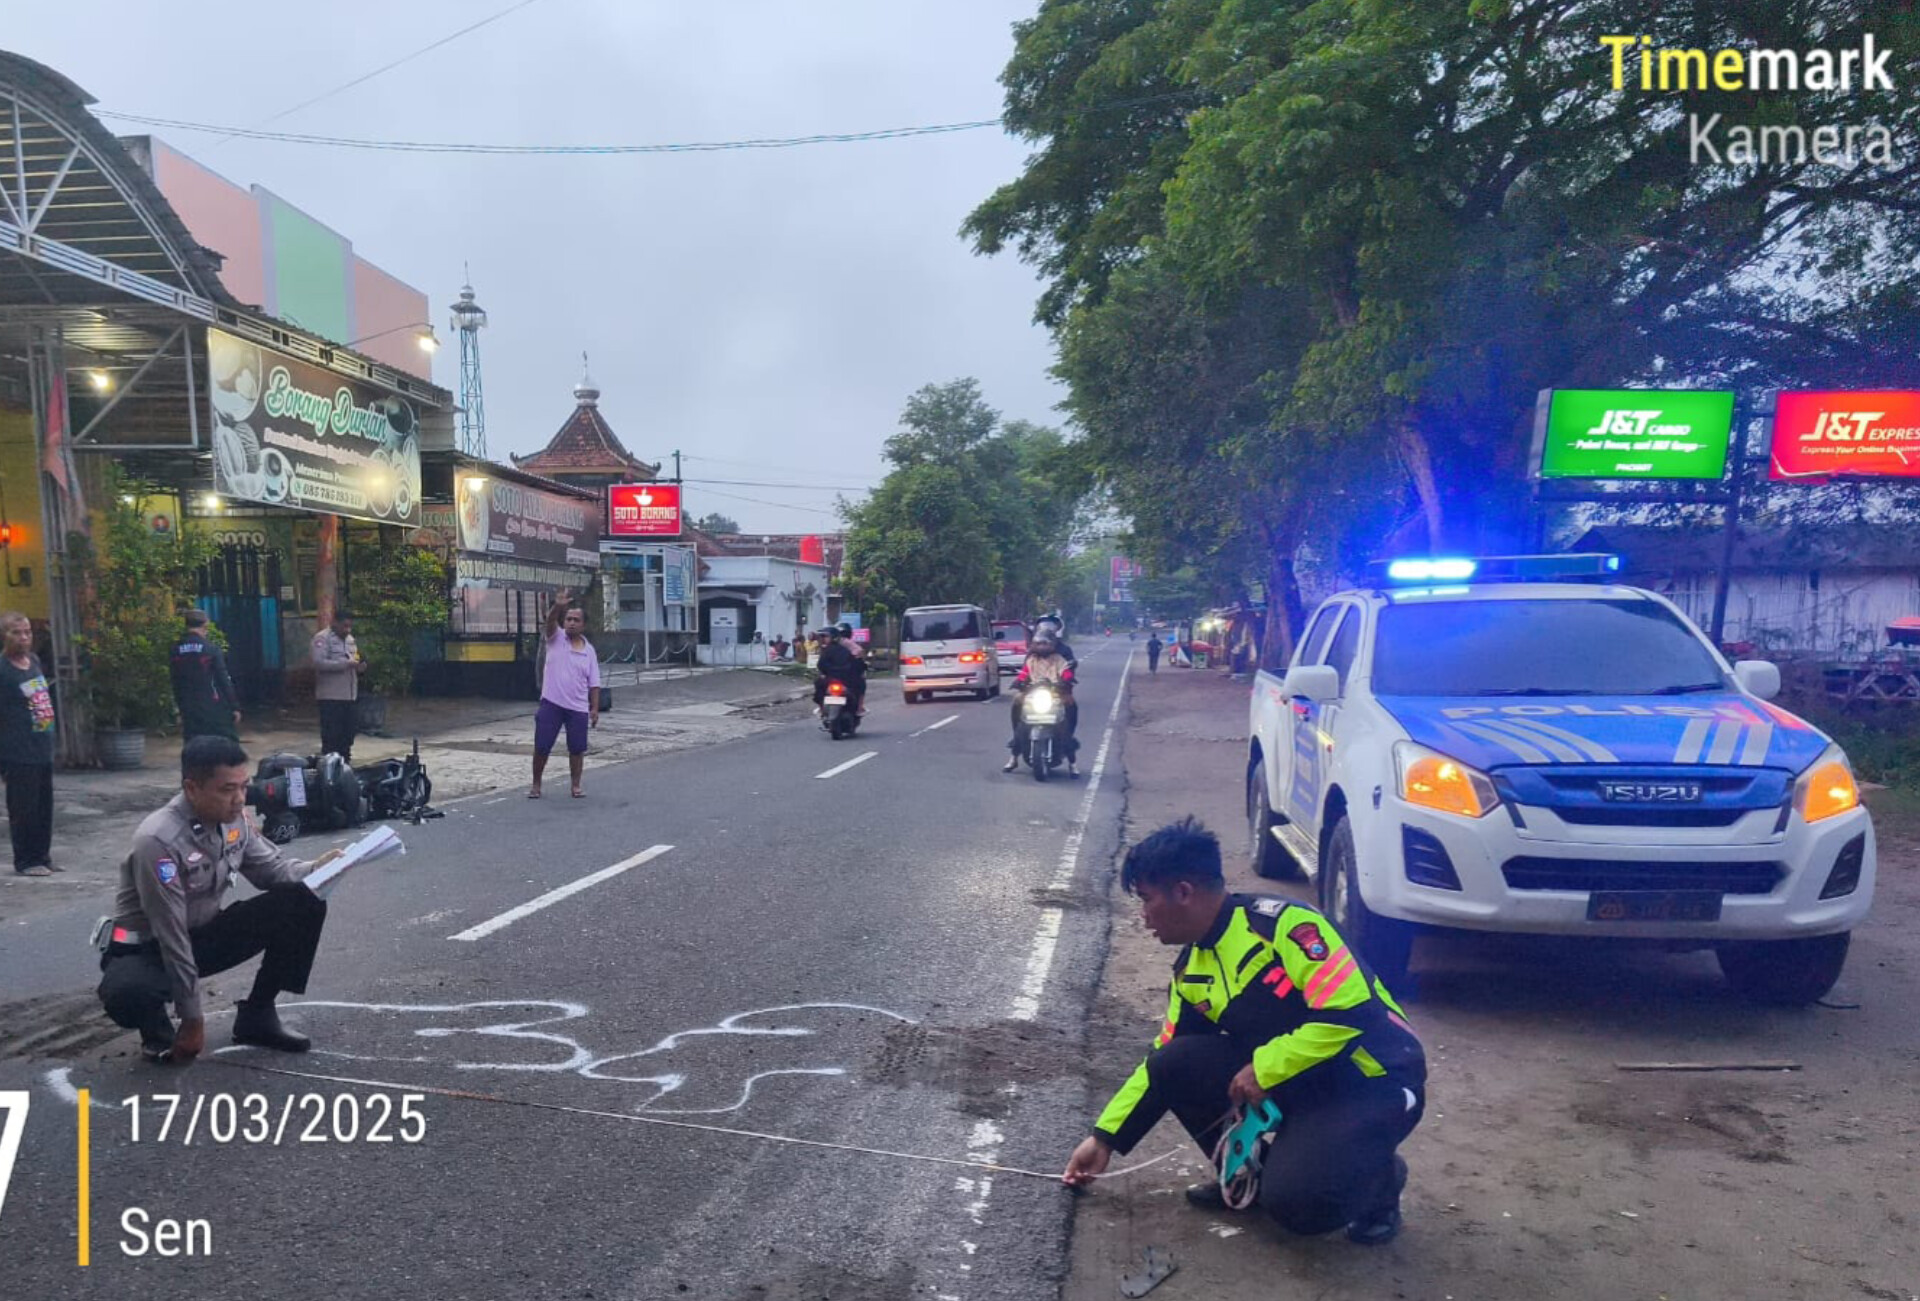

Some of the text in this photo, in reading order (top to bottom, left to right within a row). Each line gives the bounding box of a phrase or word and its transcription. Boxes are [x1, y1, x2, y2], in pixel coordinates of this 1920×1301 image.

[264, 366, 388, 444] Borang Durian
[1587, 410, 1664, 435] J&T
[1799, 412, 1886, 441] J&T
[493, 483, 521, 516] SOTO
[614, 507, 677, 519] SOTO BORANG
[1441, 705, 1745, 718] POLISI
[1605, 785, 1699, 801] ISUZU
